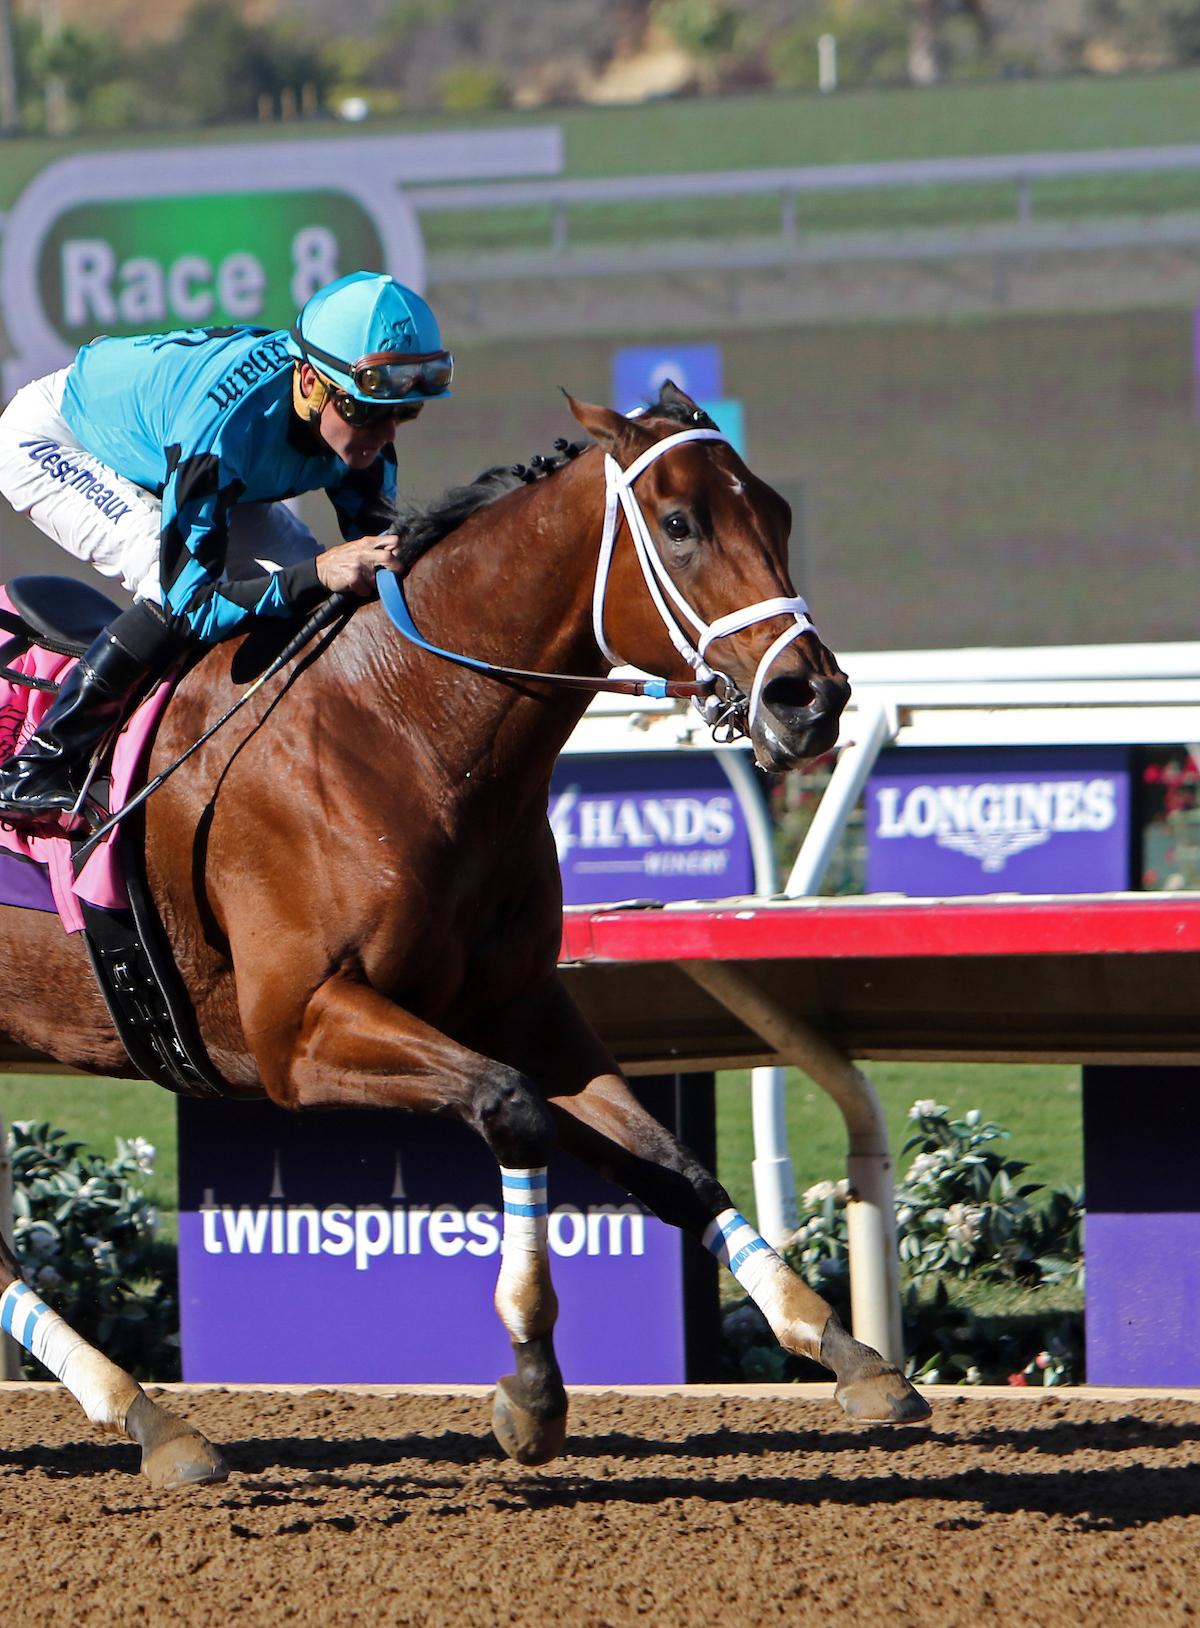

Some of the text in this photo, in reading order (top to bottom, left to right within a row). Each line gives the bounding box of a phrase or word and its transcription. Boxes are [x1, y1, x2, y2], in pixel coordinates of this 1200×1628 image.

[60, 226, 340, 328] Race 8
[208, 337, 289, 412] gham
[579, 797, 735, 849] HANDS
[876, 778, 1117, 838] LONGINES
[199, 1155, 645, 1270] twinspiresom
